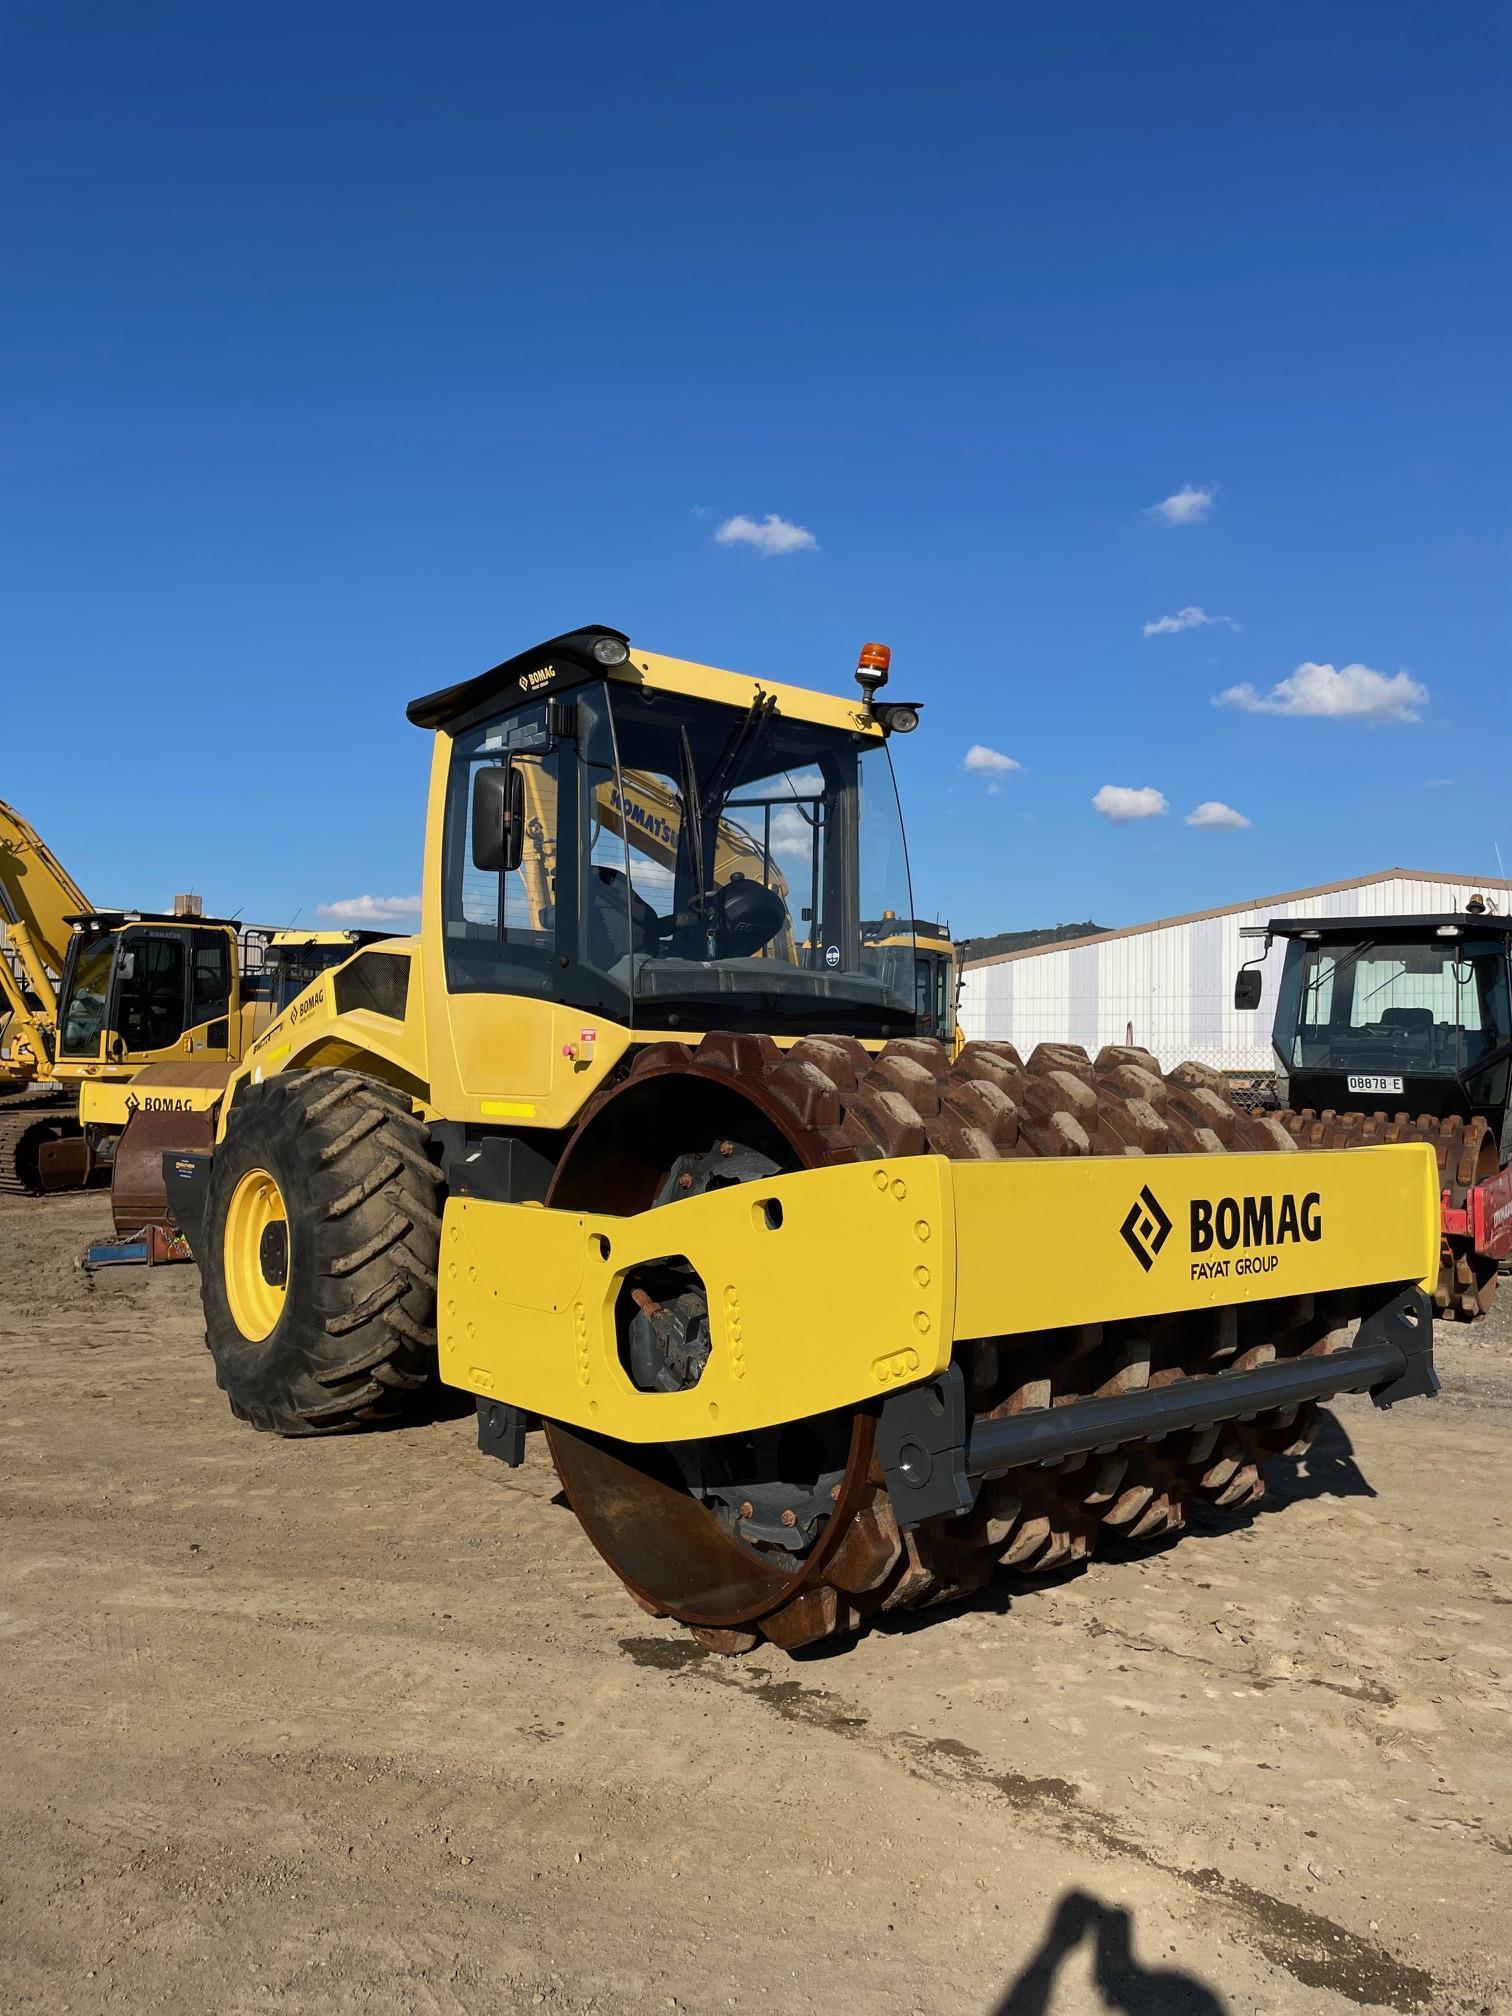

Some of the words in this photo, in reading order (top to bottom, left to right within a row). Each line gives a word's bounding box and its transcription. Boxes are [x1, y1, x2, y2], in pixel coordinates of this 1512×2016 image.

[528, 665, 556, 685] BOMAG
[300, 989, 324, 1017] BOMAG
[1350, 1077, 1387, 1089] 08878
[145, 1097, 192, 1112] BOMAG
[1190, 1192, 1321, 1252] BOMAG
[1191, 1260, 1230, 1280] FAYAT
[1235, 1255, 1278, 1275] GROUP
